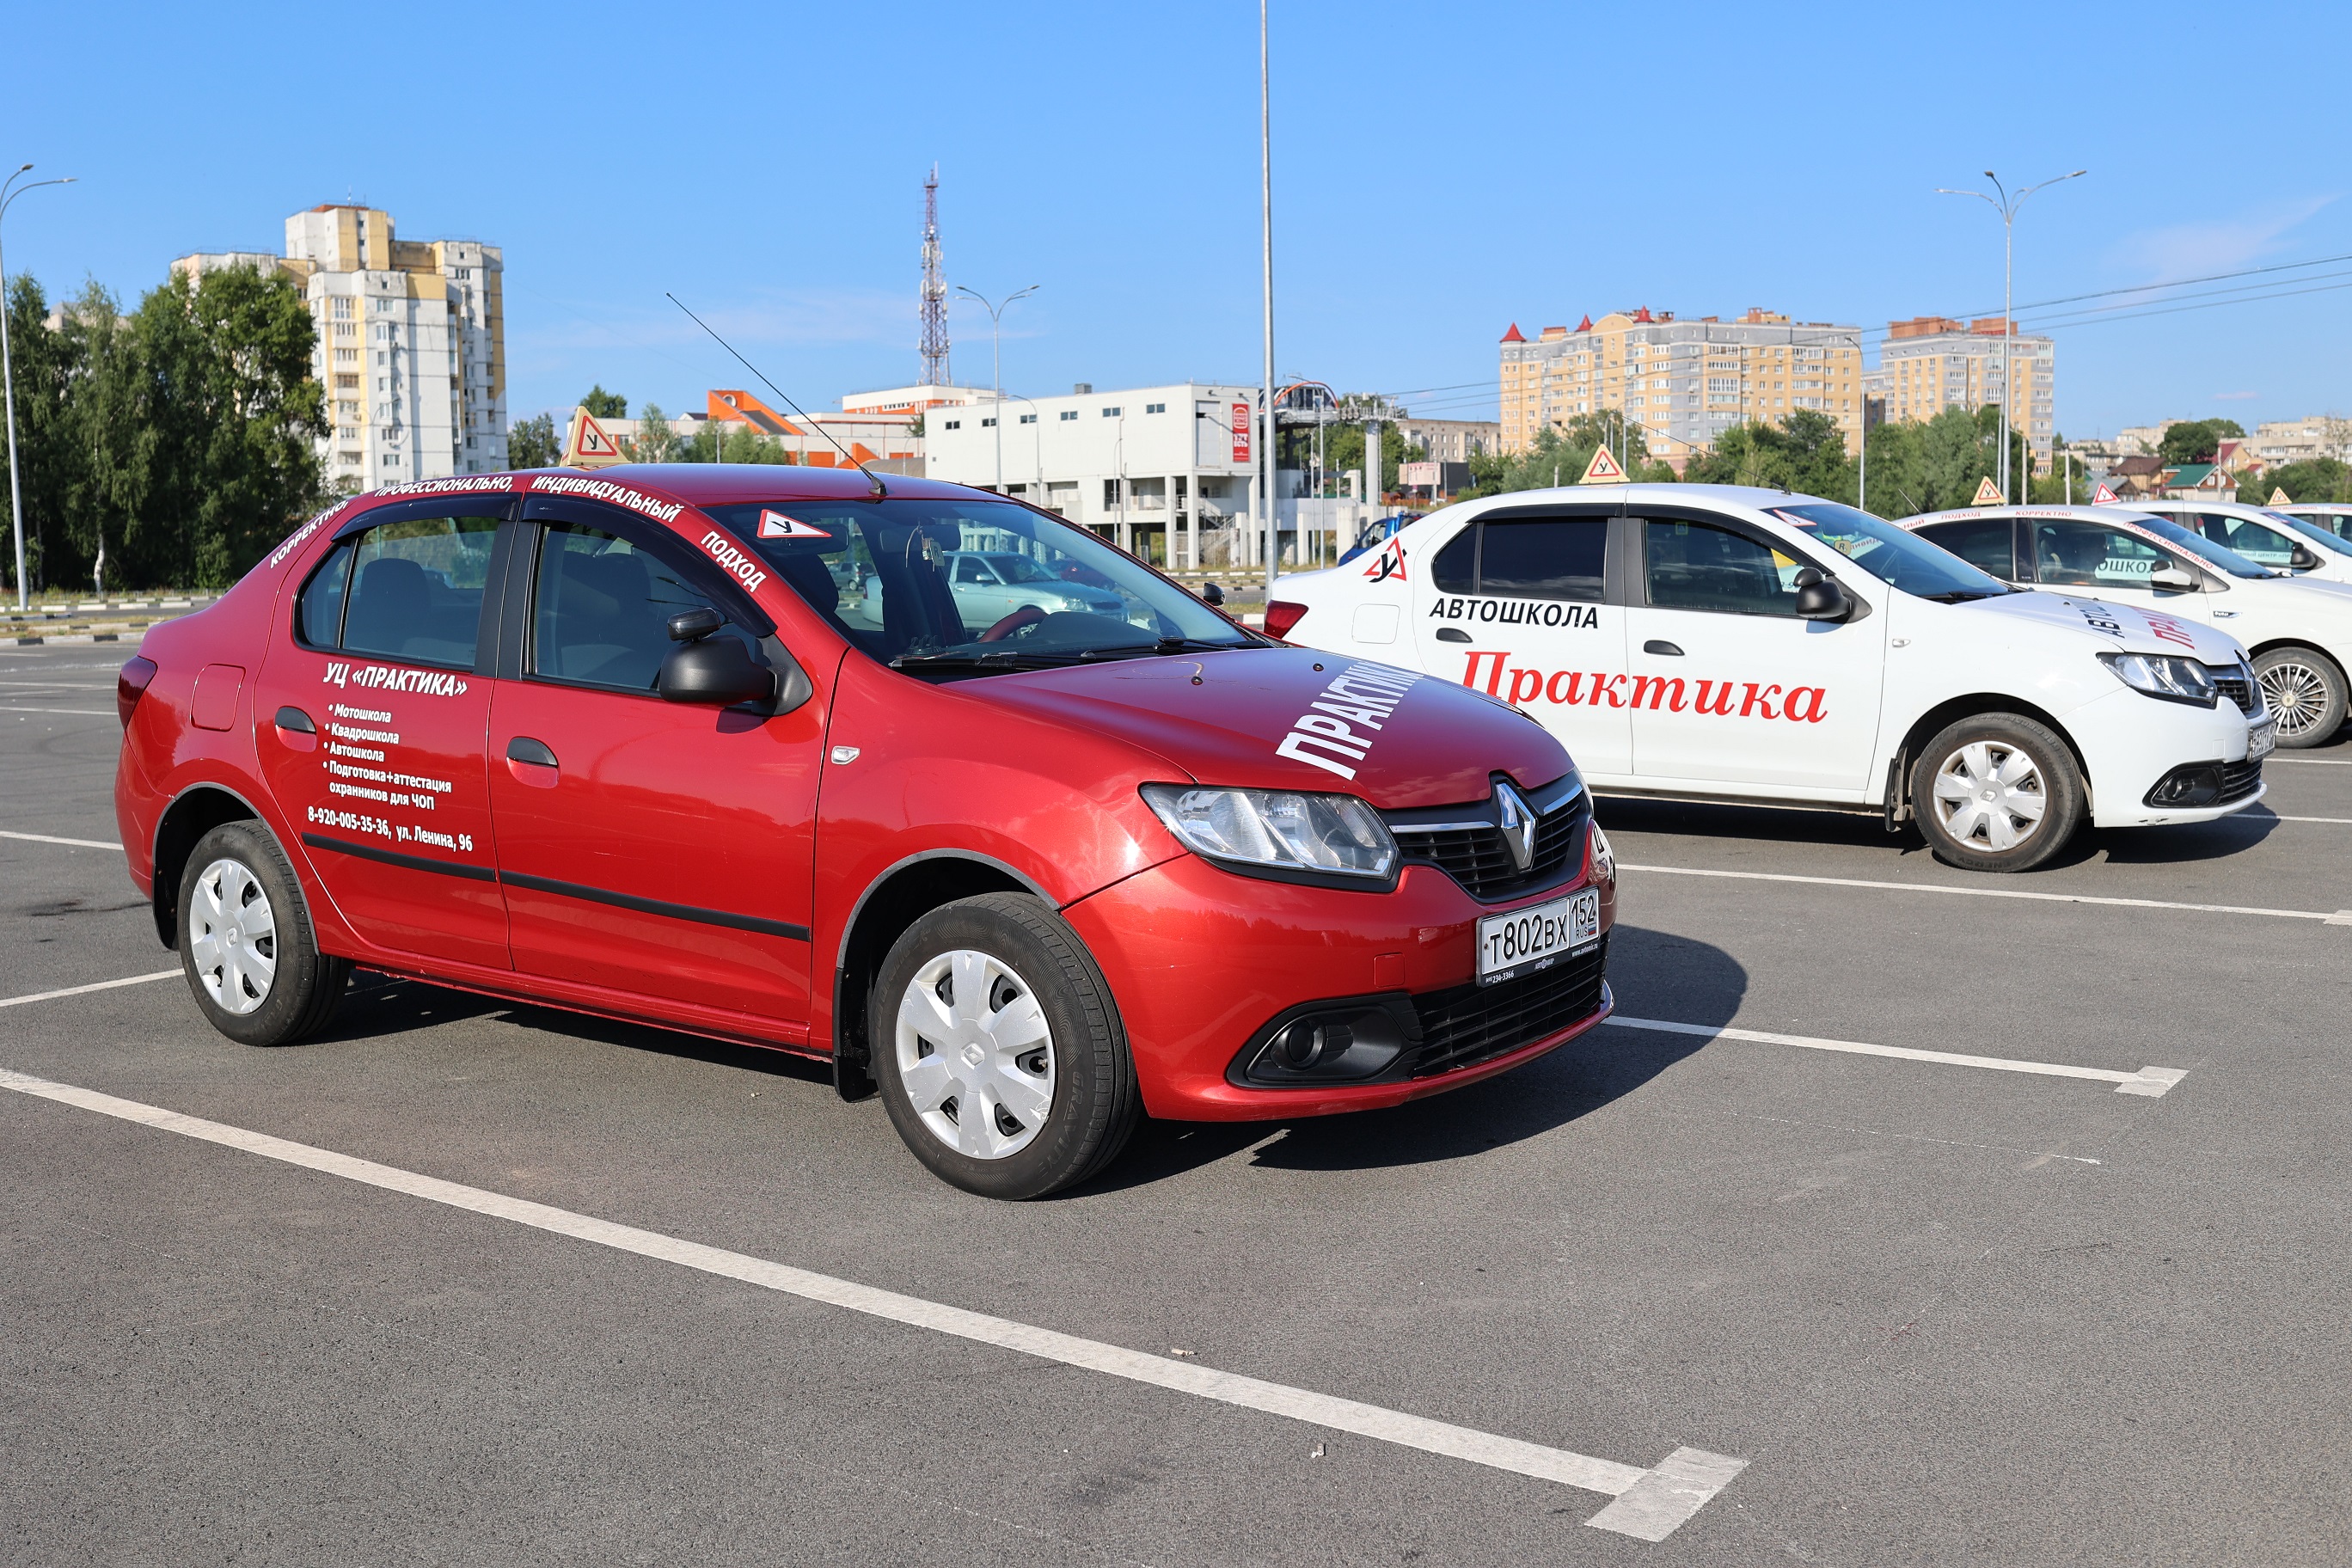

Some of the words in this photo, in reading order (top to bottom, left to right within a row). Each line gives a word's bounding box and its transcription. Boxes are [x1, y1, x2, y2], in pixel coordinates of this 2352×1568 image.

[586, 434, 597, 450] У
[531, 475, 684, 523] ИНДИВИДУАЛЬНЫЙ
[701, 530, 766, 592] ПОДХОД
[771, 520, 792, 533] У
[2123, 522, 2214, 569] ПРОФЕССИОНАЛЬНО
[1429, 598, 1599, 629] АВТОШКОЛА
[323, 662, 350, 689] УЦ
[352, 665, 468, 696] «ПРАКТИКА»
[1463, 651, 1828, 723] Практика
[334, 704, 391, 723] Мотошкола
[331, 723, 400, 744] Квадрошкола
[329, 741, 385, 763] Автошкола
[329, 761, 451, 793] Подготовка+аттестация
[329, 781, 388, 802] охранников
[390, 793, 409, 807] для
[412, 793, 435, 810] ЧОП
[308, 806, 391, 840] 8-920-005-35-36,
[395, 824, 412, 842] ул.
[414, 825, 456, 852] Ленина,
[458, 833, 474, 852] 96
[1571, 895, 1595, 926] 152
[1576, 928, 1588, 940] RUS
